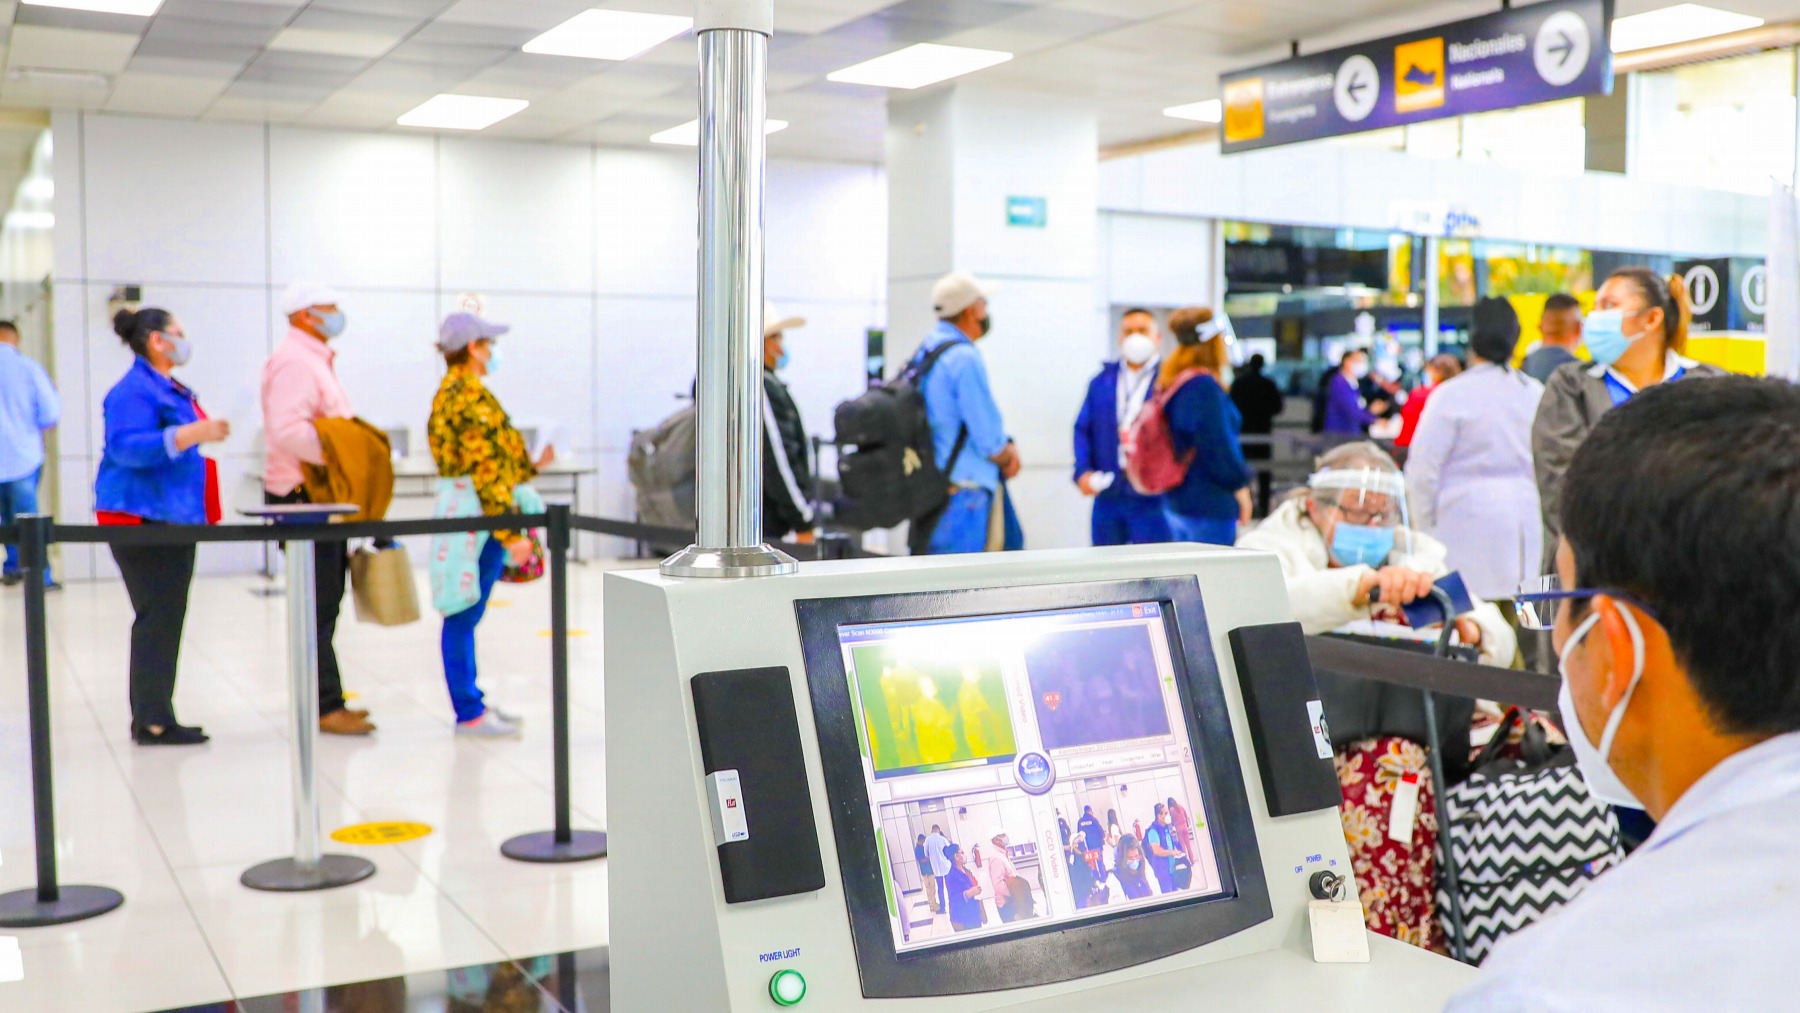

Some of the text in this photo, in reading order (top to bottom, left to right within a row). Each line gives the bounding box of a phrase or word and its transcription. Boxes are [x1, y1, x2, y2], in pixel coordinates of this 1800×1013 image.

[1449, 33, 1526, 64] Nacionales
[1143, 606, 1157, 615] Exit
[1183, 747, 1190, 758] 2
[1045, 830, 1059, 879] CCD Video
[1306, 854, 1322, 863] POWER
[759, 947, 801, 963] POWER LIGHT
